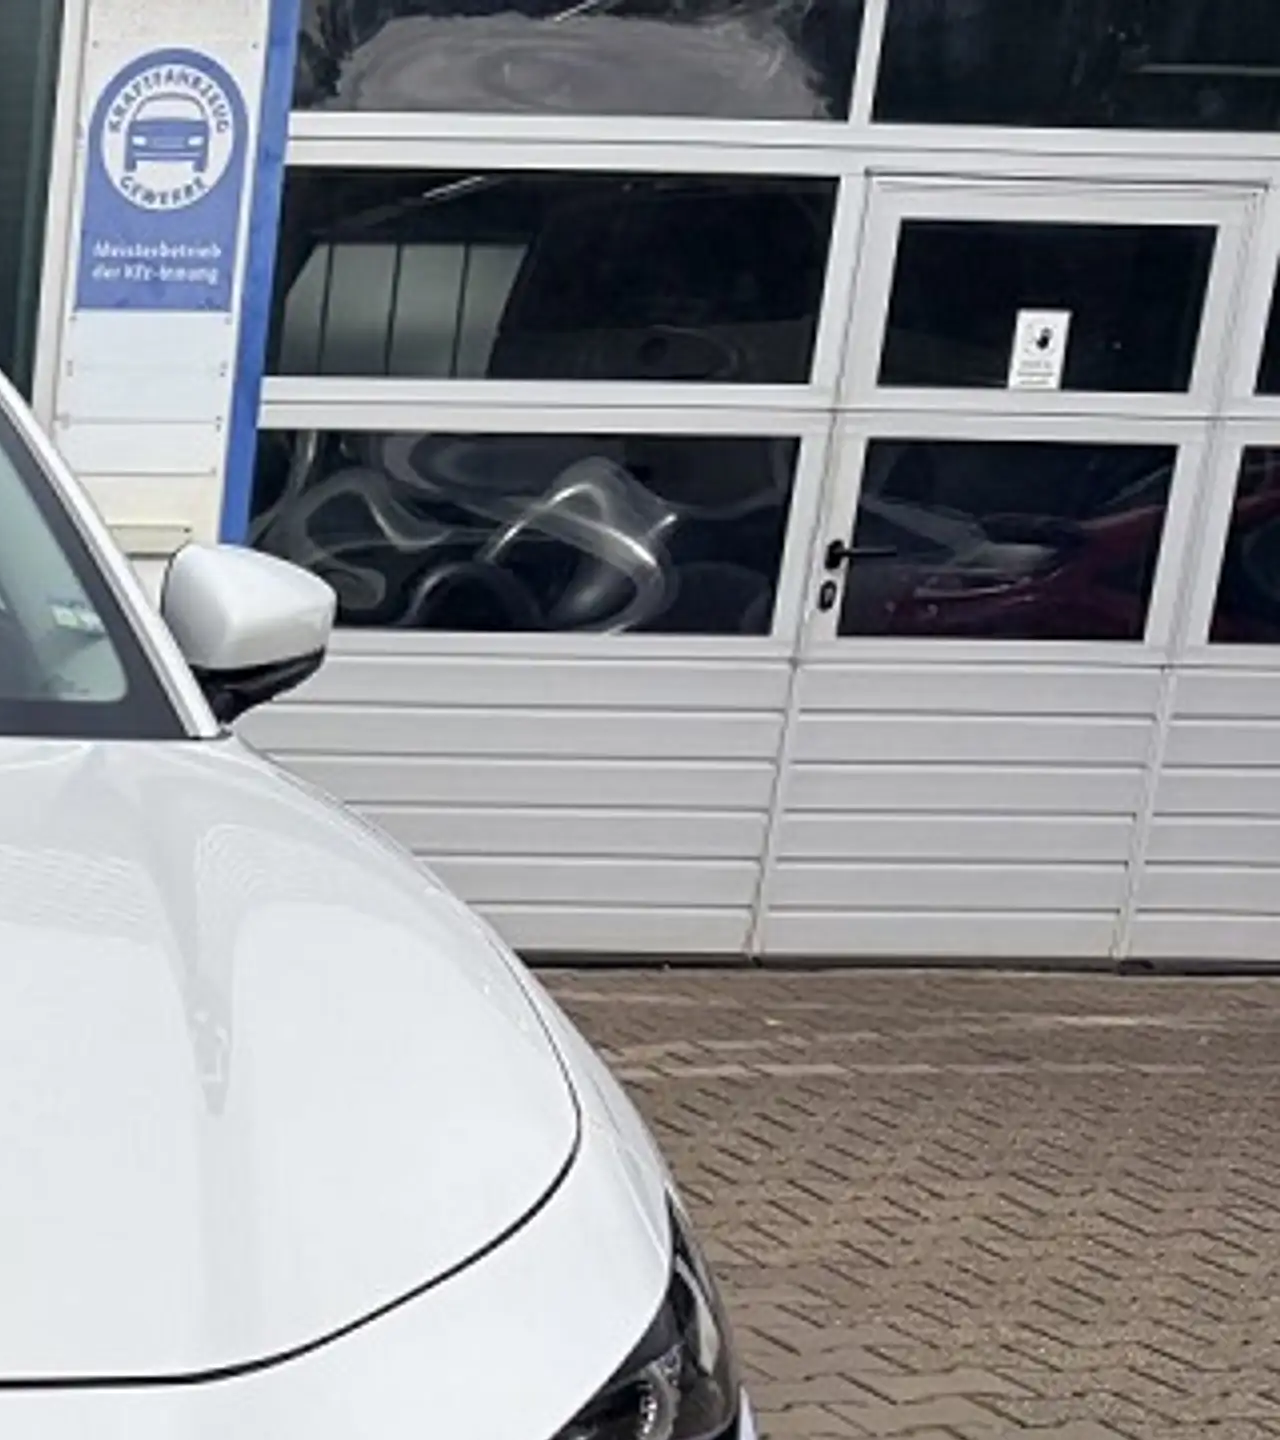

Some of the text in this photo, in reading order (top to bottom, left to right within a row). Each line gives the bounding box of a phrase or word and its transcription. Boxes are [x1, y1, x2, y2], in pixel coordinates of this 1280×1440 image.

[109, 68, 231, 133] KRAFTFAHRZEUG
[120, 175, 207, 206] GEWERBE
[92, 240, 221, 258] Meisterbetrieb
[92, 263, 120, 279] der
